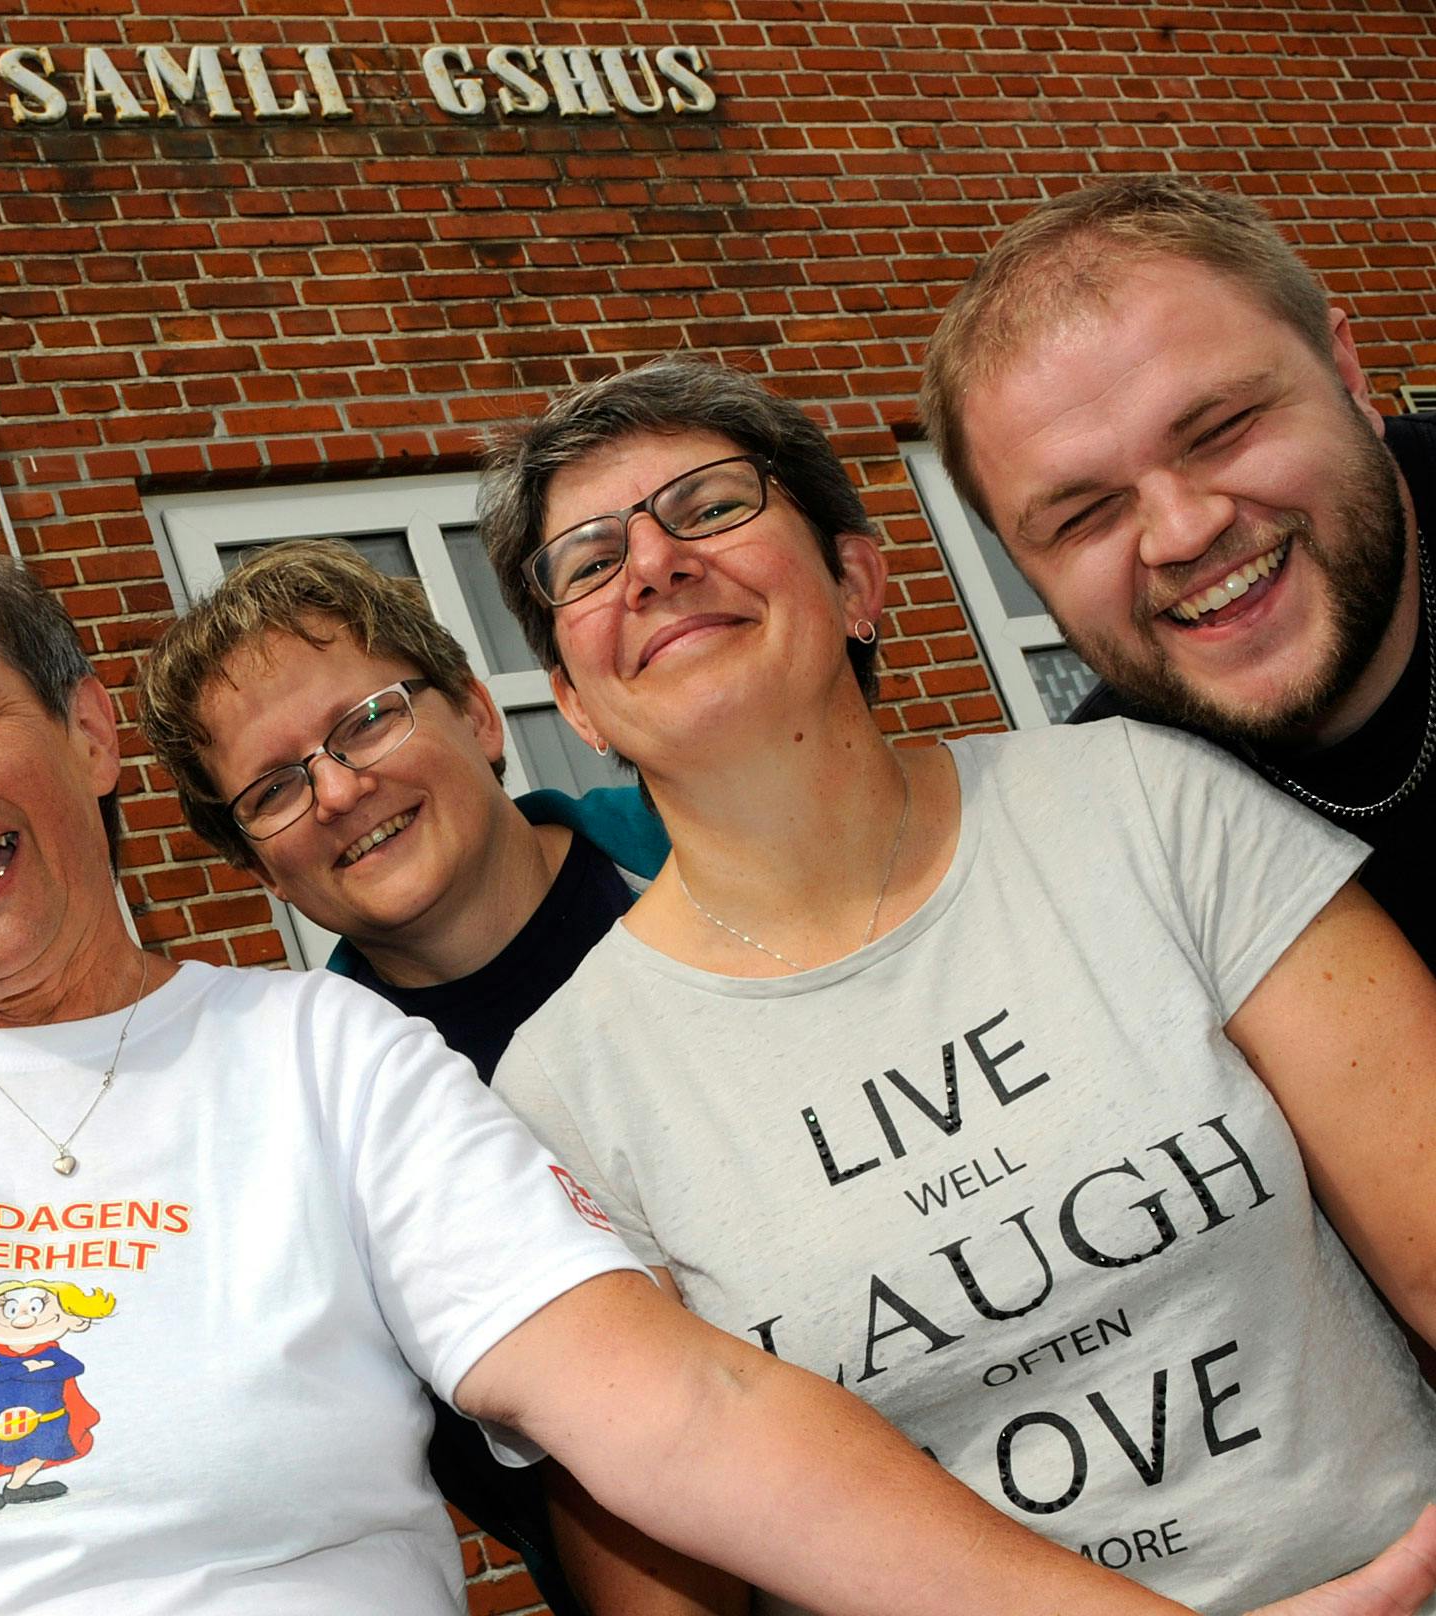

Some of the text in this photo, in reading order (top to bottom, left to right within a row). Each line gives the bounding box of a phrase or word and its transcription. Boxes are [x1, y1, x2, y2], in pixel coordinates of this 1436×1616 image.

[421, 43, 717, 118] GSHUS
[801, 1008, 1051, 1187] LIVE
[904, 1147, 1028, 1217] WELL
[982, 1308, 1134, 1388] OFTEN
[921, 1340, 1263, 1515] OVE
